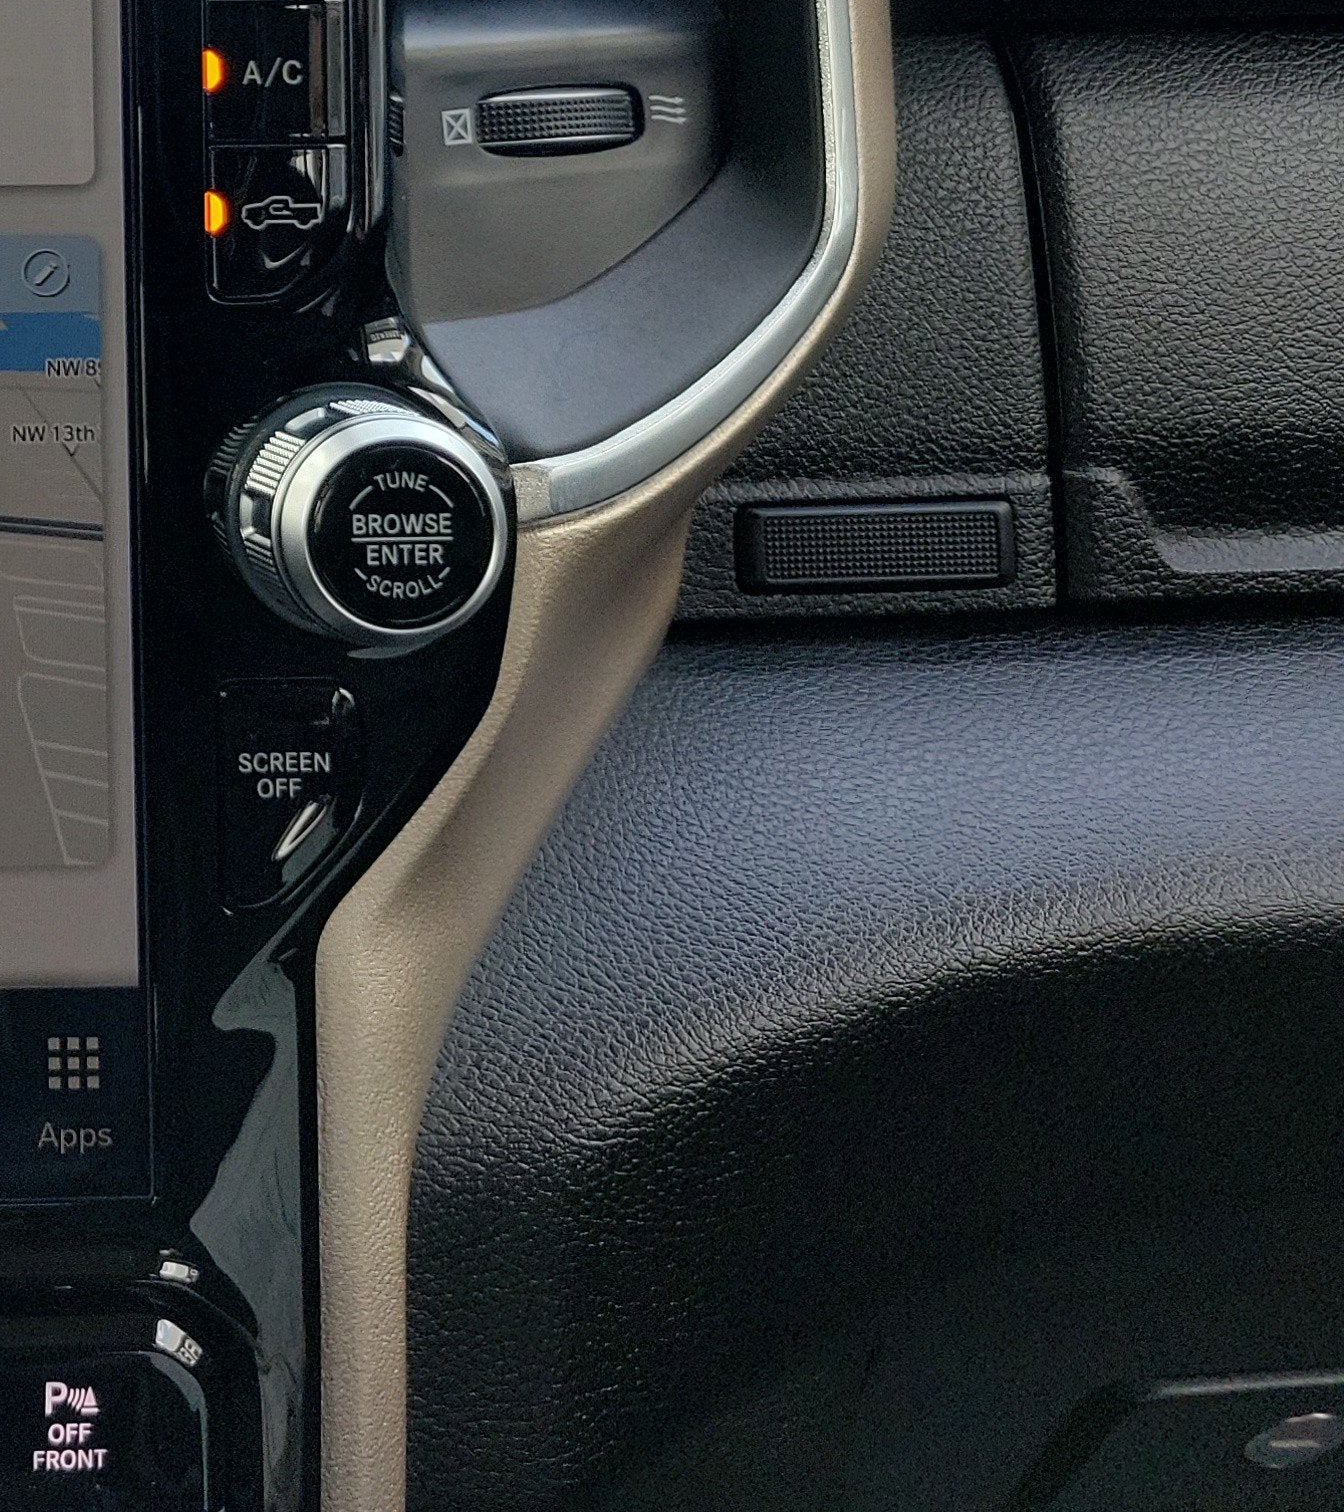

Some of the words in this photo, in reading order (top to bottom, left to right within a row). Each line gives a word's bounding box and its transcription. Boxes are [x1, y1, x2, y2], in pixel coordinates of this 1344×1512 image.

[242, 57, 304, 86] A/C
[47, 360, 80, 377] NW
[85, 359, 102, 377] 8
[12, 425, 46, 443] NW
[53, 425, 95, 442] 13th
[373, 471, 428, 493] TUNE
[352, 513, 452, 534] BROWSE
[367, 544, 443, 565] ENTER
[366, 574, 444, 599] SCROLL
[238, 753, 330, 773] SCREEN
[257, 779, 302, 799] OFF
[37, 1122, 112, 1155] Apps
[47, 1423, 92, 1444] OFF
[33, 1449, 107, 1472] FRONT
